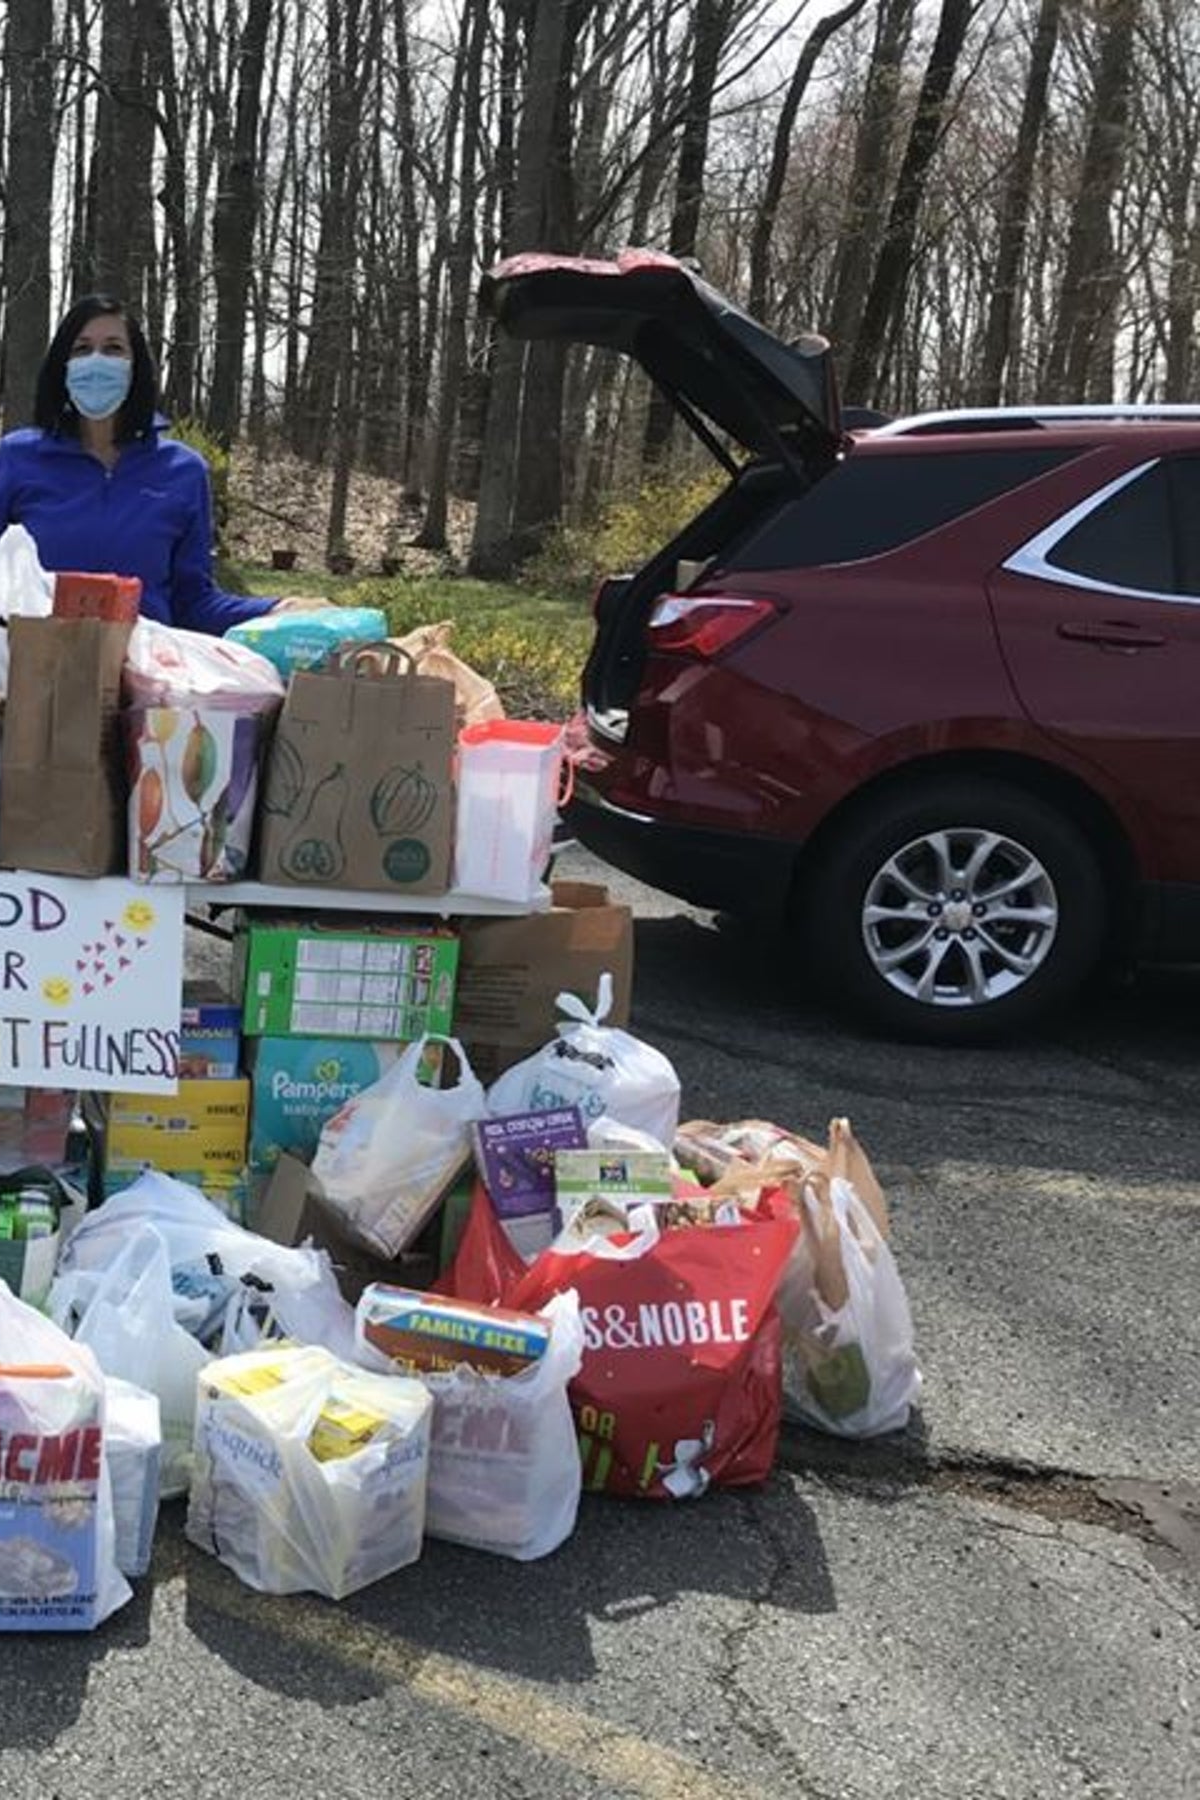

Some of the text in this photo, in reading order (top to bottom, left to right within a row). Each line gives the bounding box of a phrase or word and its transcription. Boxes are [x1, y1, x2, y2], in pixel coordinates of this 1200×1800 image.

[272, 1070, 361, 1103] Pampers
[408, 1312, 527, 1355] FAMILY SIZE
[580, 1298, 750, 1350] S&NOBLE
[580, 1403, 617, 1441] OR
